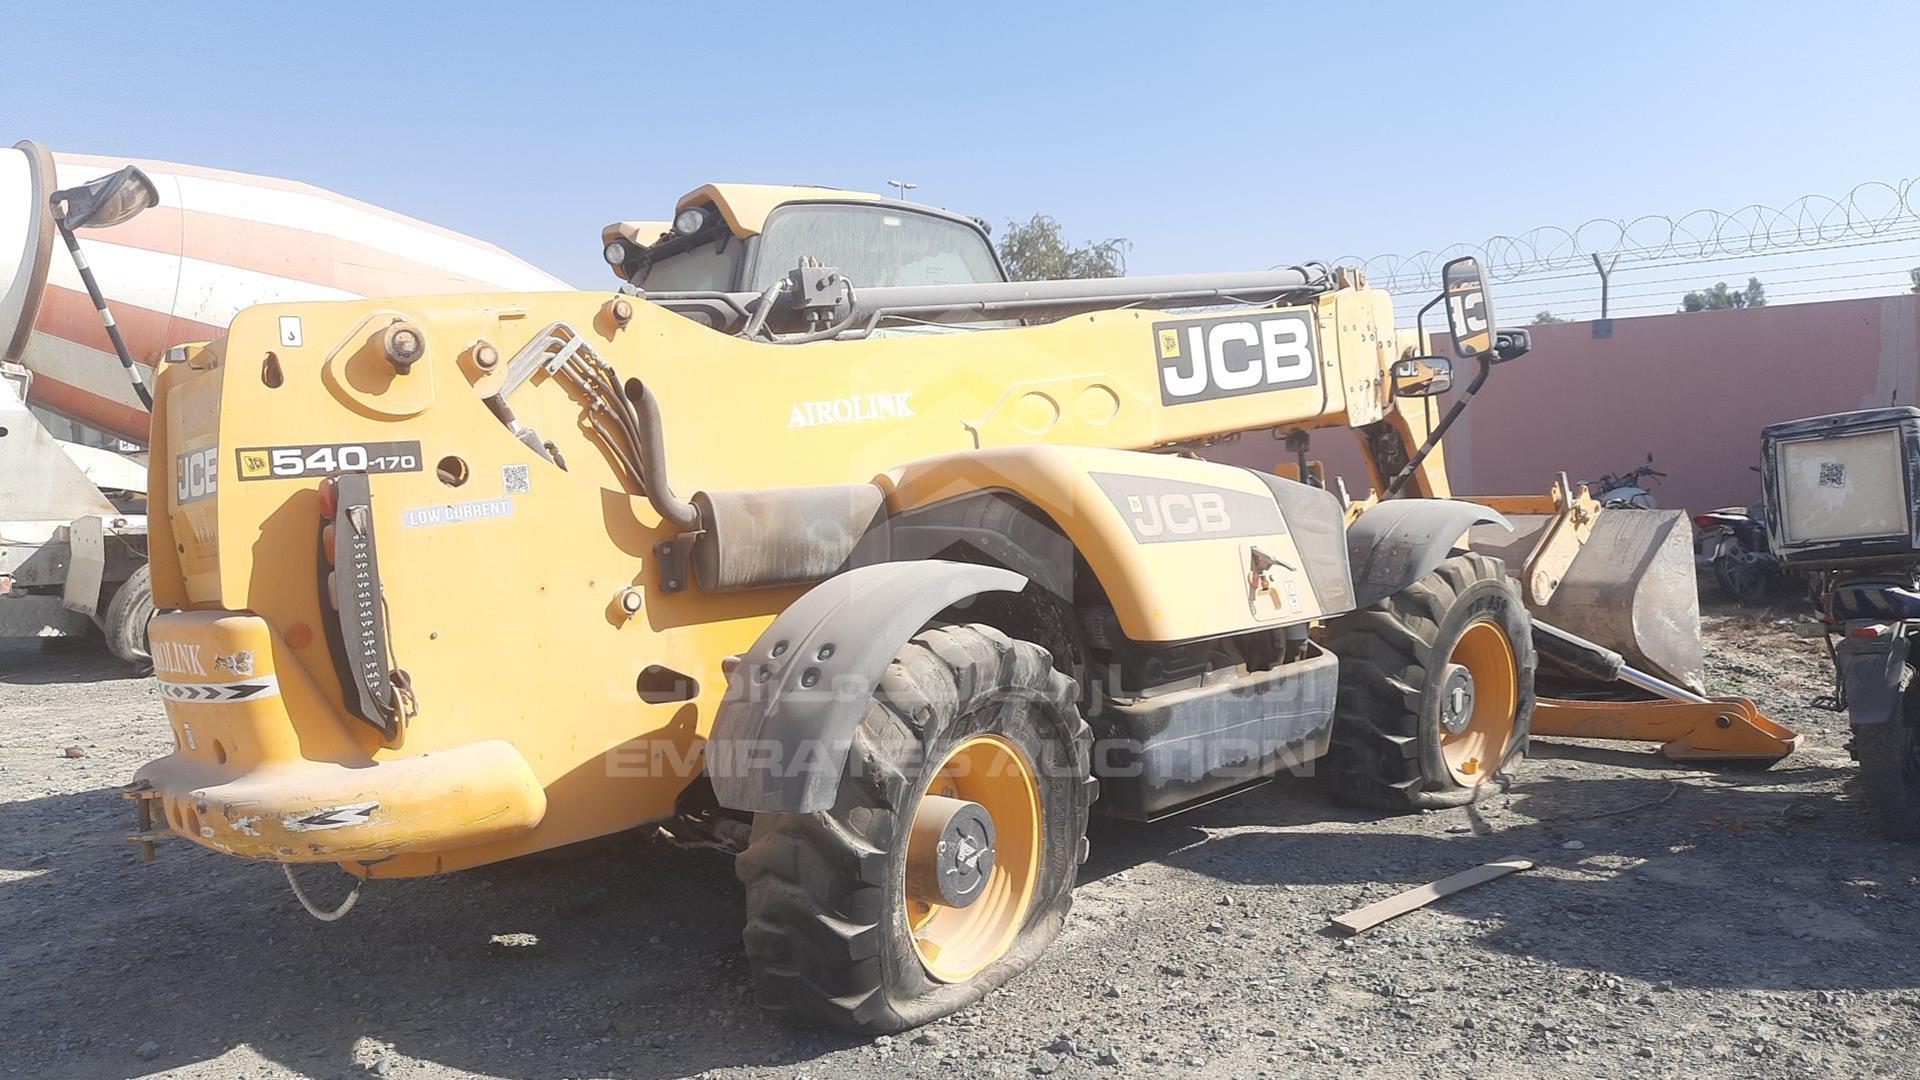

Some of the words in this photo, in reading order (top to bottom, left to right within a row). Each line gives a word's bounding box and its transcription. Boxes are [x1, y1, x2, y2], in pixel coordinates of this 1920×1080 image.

[1163, 318, 1313, 397] JCB
[786, 391, 918, 429] AIROLINK
[272, 445, 416, 475] 540-170
[409, 508, 441, 525] LOW
[445, 501, 509, 520] CURRENT
[1134, 493, 1232, 536] JCB
